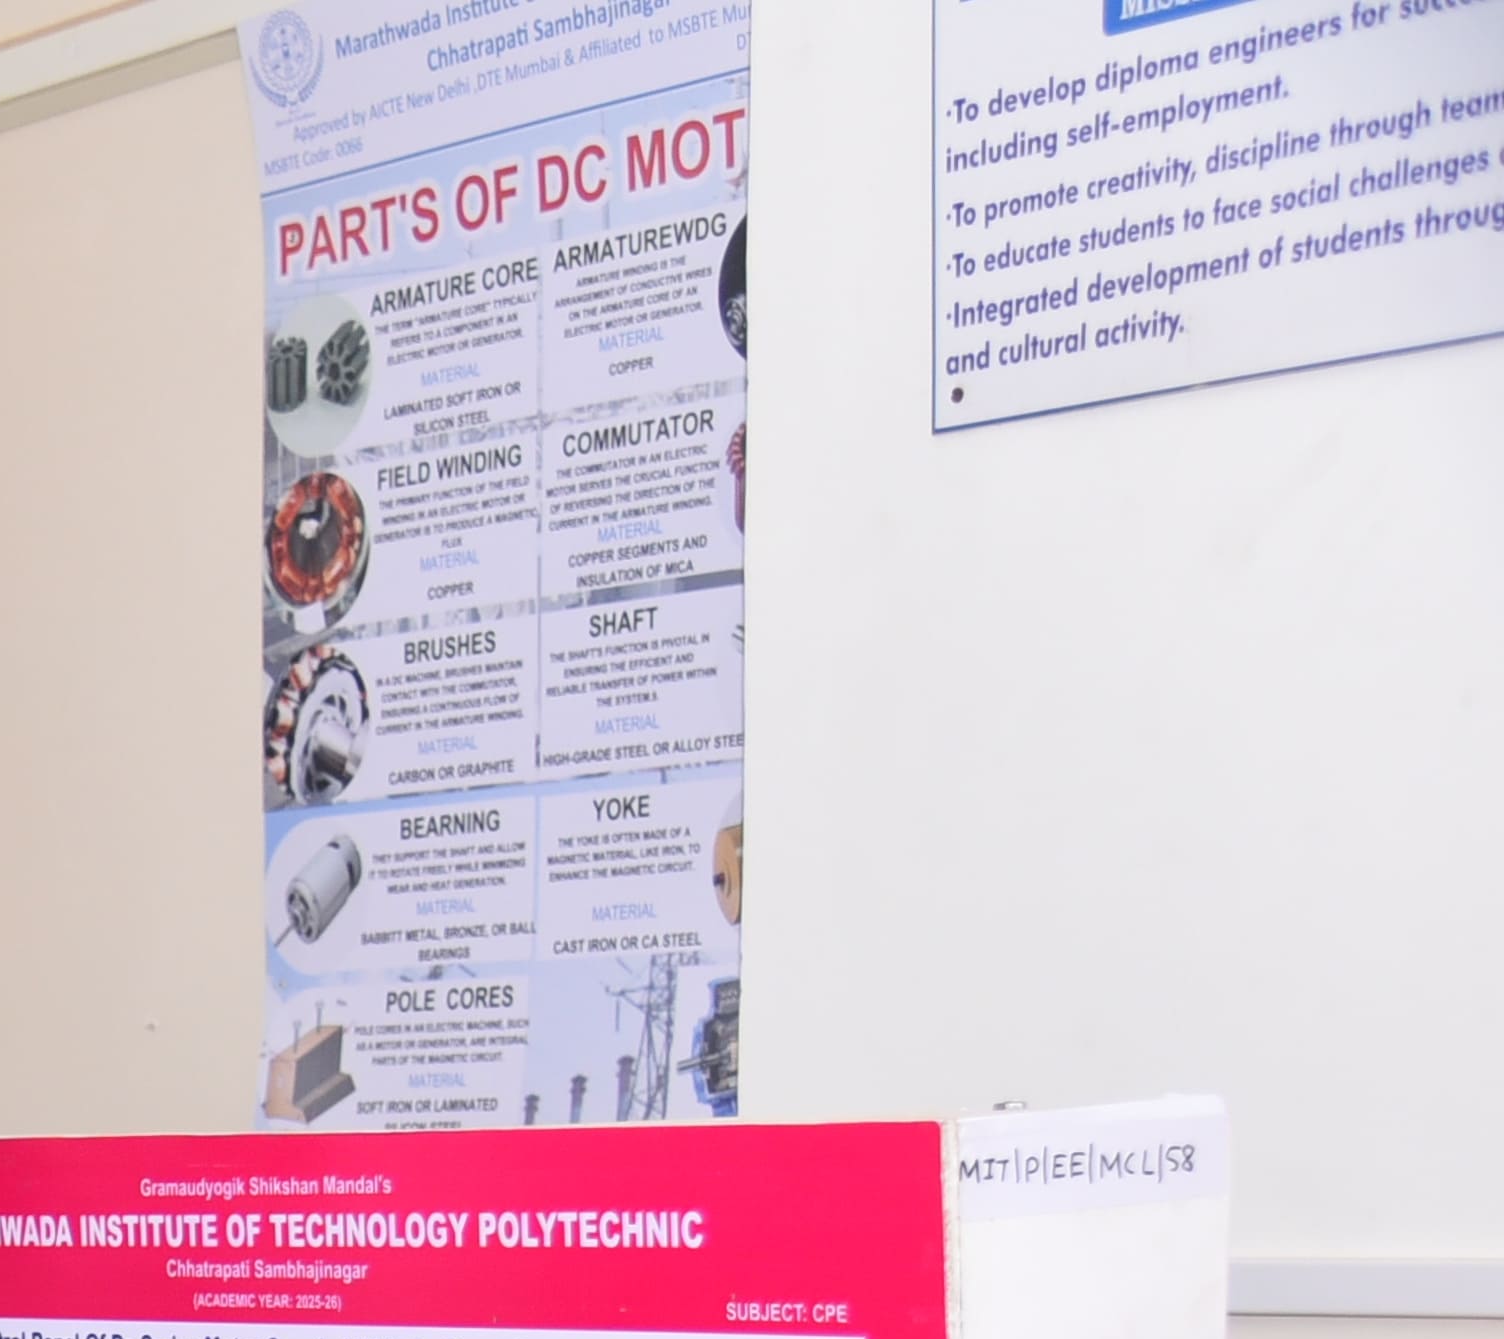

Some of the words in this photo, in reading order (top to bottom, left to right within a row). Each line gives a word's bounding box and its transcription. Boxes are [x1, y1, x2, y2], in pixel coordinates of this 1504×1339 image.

[335, 10, 441, 58] Marathwada
[427, 23, 528, 71] Chhatrapati
[505, 57, 560, 80] Mumbai
[564, 49, 575, 66] &
[579, 31, 640, 62] Affiliated
[649, 29, 664, 44] to
[668, 10, 717, 38] MSBTE
[989, 77, 1086, 116] develop
[1096, 51, 1198, 93] diploma
[1209, 16, 1342, 64] engineers
[1352, 2, 1390, 29] for
[947, 132, 1057, 172] including
[1067, 76, 1288, 146] self-employment.
[985, 184, 1078, 228] promote
[1206, 131, 1320, 173] discipline
[1330, 100, 1431, 145] through
[280, 188, 438, 275] PART'S
[456, 165, 517, 230] OF
[538, 145, 606, 212] DC
[984, 236, 1071, 271] educate
[1079, 214, 1174, 253] students
[1184, 209, 1204, 231] to
[1213, 198, 1261, 224] face
[1271, 173, 1340, 213] social
[1350, 151, 1489, 196] challenges
[554, 213, 726, 271] ARMATUREWDG
[368, 272, 474, 315] ARMATURE
[483, 258, 538, 290] CORE
[954, 277, 1077, 328] Integrated
[1087, 248, 1249, 302] development
[1259, 236, 1283, 269] of
[1292, 219, 1404, 262] students
[607, 354, 655, 379] COPPER
[946, 343, 989, 375] and
[999, 325, 1086, 365] cultural
[505, 382, 520, 395] OR
[563, 410, 713, 457] COMMUTATOR
[378, 462, 430, 489] FIELD
[435, 445, 524, 481] WINDING
[566, 547, 616, 571] COPPER
[616, 537, 682, 564] SEGMENTS
[683, 535, 707, 549] AND
[574, 564, 645, 590] INSULATION
[647, 564, 660, 578] OF
[666, 560, 693, 574] MICA
[590, 607, 657, 637] SHAFT
[402, 631, 495, 664] BRUSHES
[613, 741, 652, 762] STEEL
[653, 742, 669, 755] OR
[673, 738, 710, 752] ALLOY
[398, 808, 503, 843] BEARNING
[593, 795, 649, 820] YOKE
[554, 940, 584, 954] CAST
[587, 935, 619, 955] IRON
[621, 936, 640, 950] OR
[642, 935, 658, 949] CA
[660, 930, 704, 951] STEEL
[387, 990, 435, 1012] POLE
[447, 986, 513, 1010] CORES
[141, 1178, 245, 1200] Gramaudyogik
[250, 1177, 318, 1195] Shikshan
[324, 1176, 391, 1194] Mandal's
[81, 1215, 218, 1247] INSTITUTE
[227, 1214, 260, 1247] OF
[270, 1213, 468, 1247] TECHNOLOGY
[478, 1211, 704, 1248] POLYTECHNIC
[167, 1259, 250, 1281] Chhatrapati
[255, 1260, 368, 1283] Sambhajinagar
[727, 1303, 805, 1321] SUBJECT:
[813, 1304, 846, 1322] CPE
